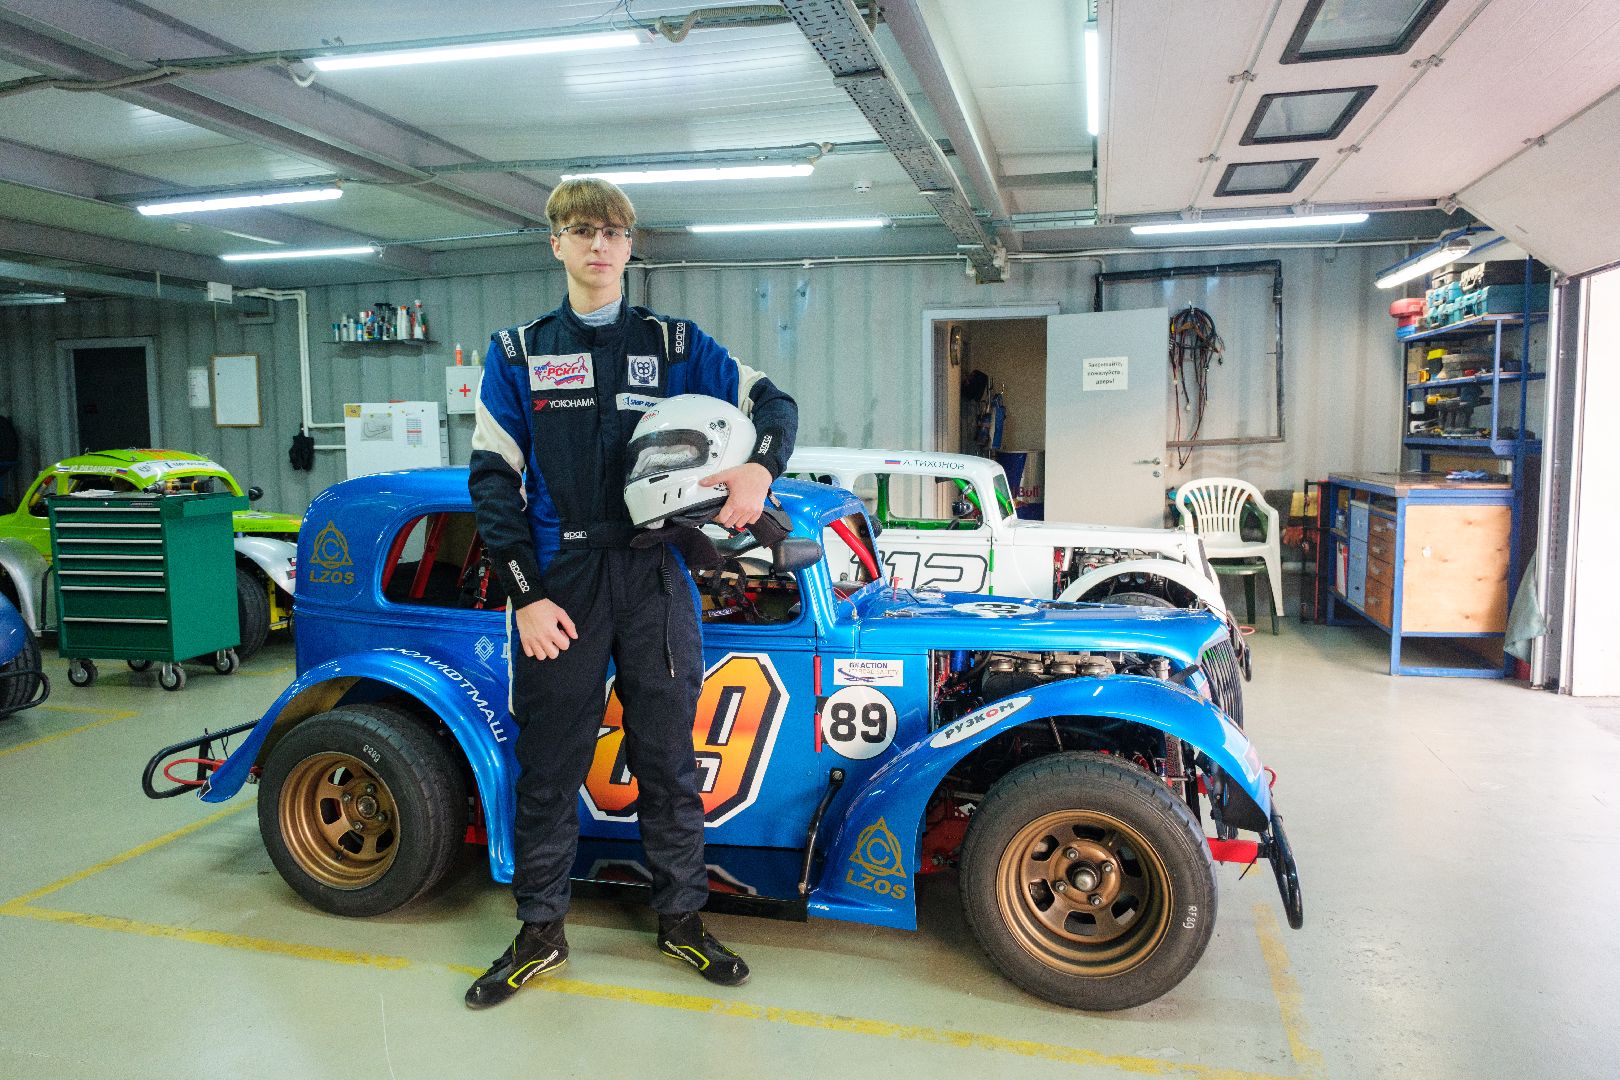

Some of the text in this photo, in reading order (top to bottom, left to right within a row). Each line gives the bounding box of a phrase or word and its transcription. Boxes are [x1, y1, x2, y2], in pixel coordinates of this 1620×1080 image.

[548, 397, 595, 409] YOKOHAMA
[309, 570, 354, 585] LZOS
[508, 559, 530, 593] sparco
[829, 702, 888, 743] 89
[944, 701, 1015, 740] РУЗКОМ
[845, 869, 907, 900] LZOS
